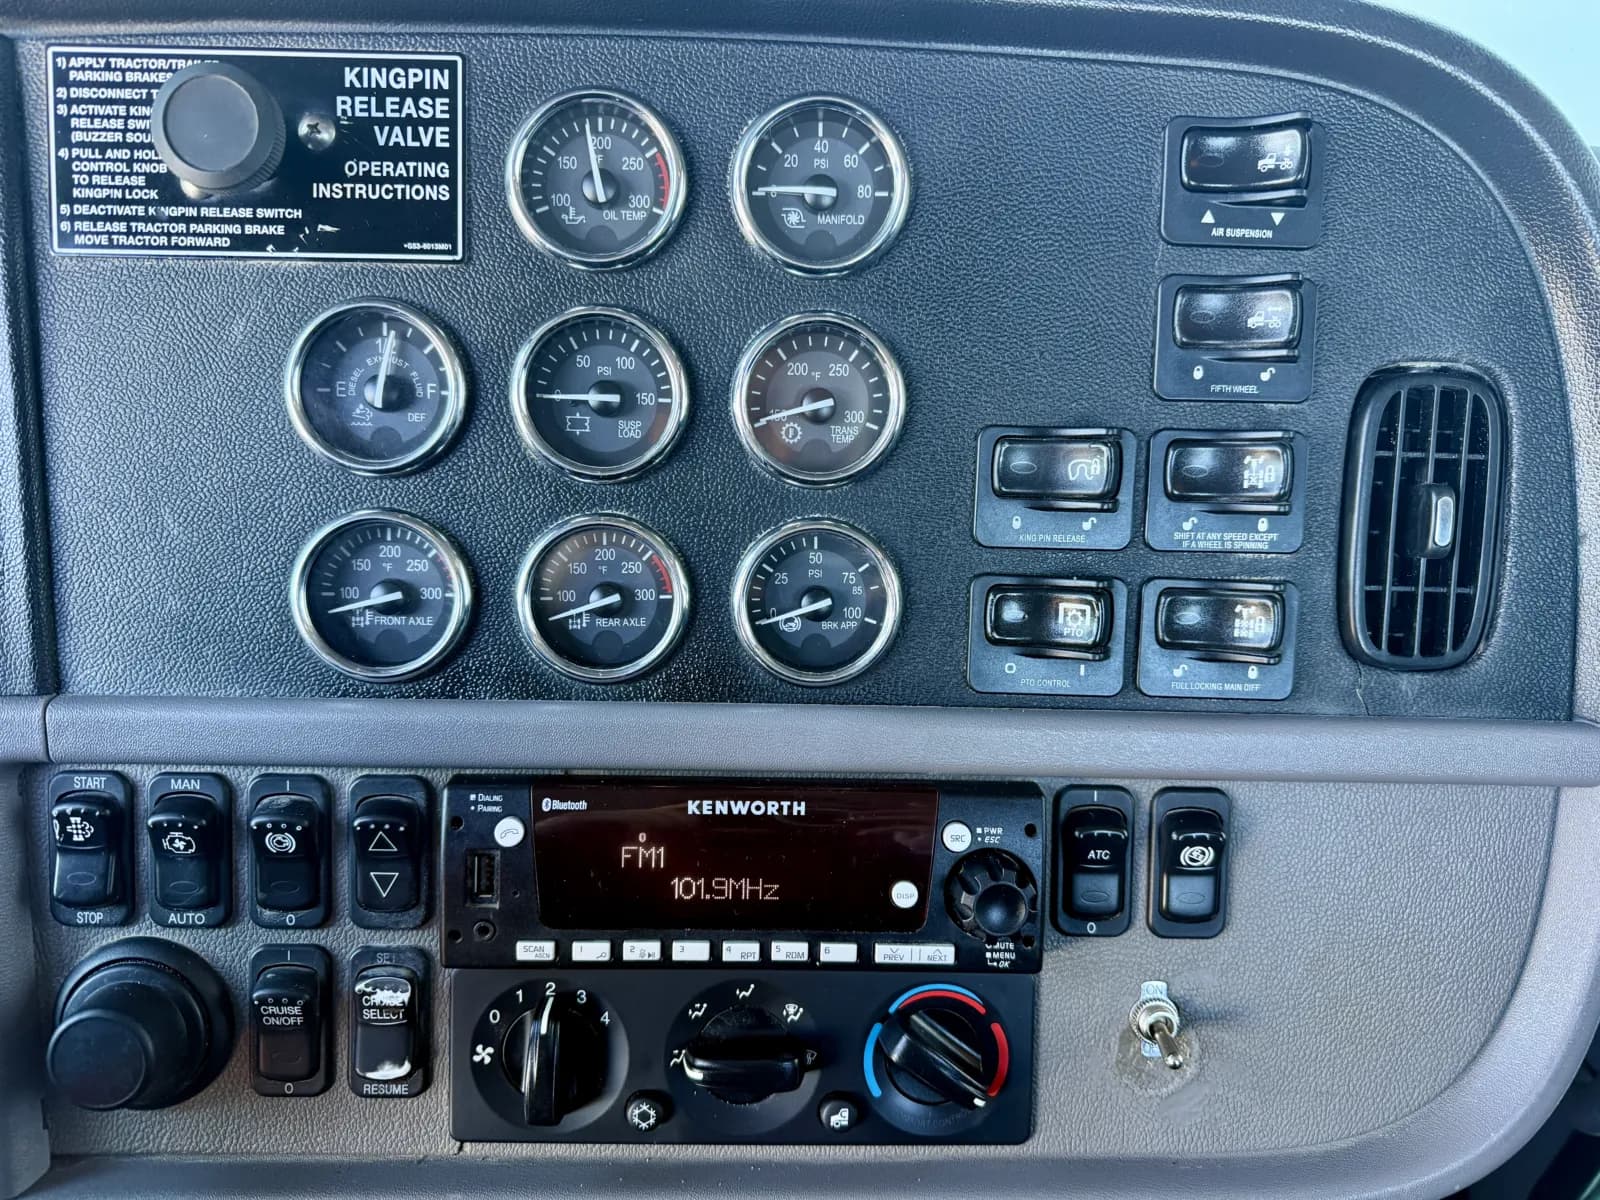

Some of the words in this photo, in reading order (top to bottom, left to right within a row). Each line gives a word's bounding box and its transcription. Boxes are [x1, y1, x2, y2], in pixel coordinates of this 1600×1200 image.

[56, 57, 66, 69] 1)
[69, 57, 106, 69] APPLY
[69, 71, 122, 82] PARKING
[344, 67, 449, 90] KINGPIN
[56, 87, 67, 99] 2)
[70, 88, 148, 99] DISCONNECT
[57, 105, 67, 116] 3)
[70, 105, 126, 116] ACTIVATE
[336, 96, 450, 118] RELEASE
[70, 118, 125, 129] RELEASE
[71, 131, 123, 144] (BUZZER
[374, 126, 450, 147] VALVE
[814, 140, 829, 153] 40
[57, 148, 69, 160] 4)
[72, 148, 102, 159] PULL
[105, 149, 130, 160] AND
[557, 156, 577, 170] 150
[622, 158, 644, 171] 250
[784, 154, 798, 168] 20
[814, 159, 829, 169] PSI
[843, 155, 858, 168] 60
[72, 161, 130, 172] CONTROL
[133, 163, 167, 174] KNOB
[344, 161, 450, 178] OPERATING
[72, 175, 89, 185] TO
[92, 175, 146, 186] RELEASE
[72, 188, 122, 199] KINGPIN
[125, 189, 159, 200] LOCK
[312, 183, 450, 200] INSTRUCTIONS
[857, 185, 872, 199] 80
[551, 194, 571, 207] 100
[628, 195, 650, 209] 300
[60, 204, 70, 216] 5)
[73, 205, 145, 216] DEACTIVATE
[200, 207, 254, 218] RELEASE
[256, 208, 302, 219] SWITCH
[603, 210, 618, 220] OIL
[621, 211, 647, 221] TEMP
[817, 214, 864, 225] MANIFOLD
[60, 222, 71, 233] 6)
[74, 222, 127, 233] RELEASE
[130, 222, 186, 234] TRACTOR
[190, 223, 242, 235] PARKING
[244, 224, 285, 235] BRAKE
[1211, 227, 1225, 237] AIR
[1225, 228, 1273, 238] SUSPENSION
[74, 234, 108, 245] MOVE
[111, 235, 168, 246] TRACTOR
[171, 236, 231, 247] FORWARD
[576, 355, 590, 368] 50
[615, 356, 635, 370] 100
[597, 366, 612, 376] PSI
[787, 362, 808, 376] 200
[828, 364, 849, 377] 250
[347, 367, 365, 396] DIESEL
[410, 371, 424, 398] FLUID
[336, 381, 346, 397] E
[427, 383, 437, 400] F
[1210, 384, 1232, 393] FIFTH
[1232, 385, 1260, 394] WHEEL
[635, 392, 655, 406] 150
[407, 412, 427, 422] DEF
[844, 410, 864, 424] 300
[618, 420, 641, 429] SUSP
[830, 426, 859, 435] TRANS
[618, 429, 641, 439] LOAD
[831, 434, 856, 444] TEMP
[1019, 534, 1037, 542] KING
[1039, 534, 1051, 542] PIN
[1052, 535, 1086, 543] RELEASE
[1174, 532, 1195, 540] SHIFT
[1196, 532, 1207, 540] AT
[1207, 532, 1222, 540] ANY
[1223, 533, 1248, 541] SPEED
[1249, 533, 1279, 541] EXCEPT
[1198, 541, 1223, 549] WHEEL
[1224, 541, 1232, 549] IS
[1233, 541, 1269, 549] SPINNING
[379, 545, 401, 558] 200
[595, 548, 616, 561] 200
[809, 552, 823, 564] 50
[351, 559, 371, 572] 150
[406, 559, 429, 572] 250
[568, 562, 587, 575] 150
[621, 562, 642, 574] 250
[774, 573, 789, 585] 25
[808, 569, 823, 579] PSI
[842, 572, 856, 584] 75
[340, 586, 360, 600] 100
[420, 587, 442, 600] 300
[557, 590, 576, 602] 100
[634, 589, 655, 601] 300
[852, 586, 862, 595] 85
[842, 607, 862, 619] 100
[374, 616, 407, 625] FRONT
[408, 616, 434, 626] AXLE
[596, 618, 621, 627] REAR
[623, 618, 647, 627] AXLE
[821, 622, 839, 630] BRK
[840, 622, 858, 630] APP
[1063, 627, 1084, 637] PTO
[1037, 679, 1071, 688] CONTROL
[1171, 681, 1190, 689] FULL
[1190, 682, 1222, 690] LOCKING
[1224, 683, 1243, 691] MAIN
[73, 777, 107, 789] START
[171, 778, 200, 790] MAN
[552, 800, 588, 810] Bluetooth
[687, 800, 806, 815] KENWORTH
[984, 827, 1003, 835] PWR
[984, 836, 1001, 844] ESC
[621, 846, 665, 869] FM1
[1088, 850, 1111, 860] ATC
[670, 877, 780, 900] 101.9MHz
[76, 912, 103, 923] STOP
[168, 913, 205, 925] AUTO
[522, 945, 545, 953] SCAN
[629, 945, 636, 953] 2
[679, 945, 685, 953] 3
[740, 952, 757, 960] RPT
[785, 952, 805, 960] RDM
[883, 953, 905, 961] PREV
[927, 954, 947, 962] NEXT
[545, 982, 556, 996] 2
[1145, 984, 1163, 994] ON
[516, 989, 523, 1003] 1
[576, 990, 587, 1004] 3
[260, 1006, 303, 1015] CRUISE
[362, 1008, 405, 1020] SELECT
[489, 1009, 500, 1024] 0
[262, 1016, 304, 1026] ON/OFF
[600, 1010, 610, 1025] 4
[363, 1084, 409, 1095] RESUME
